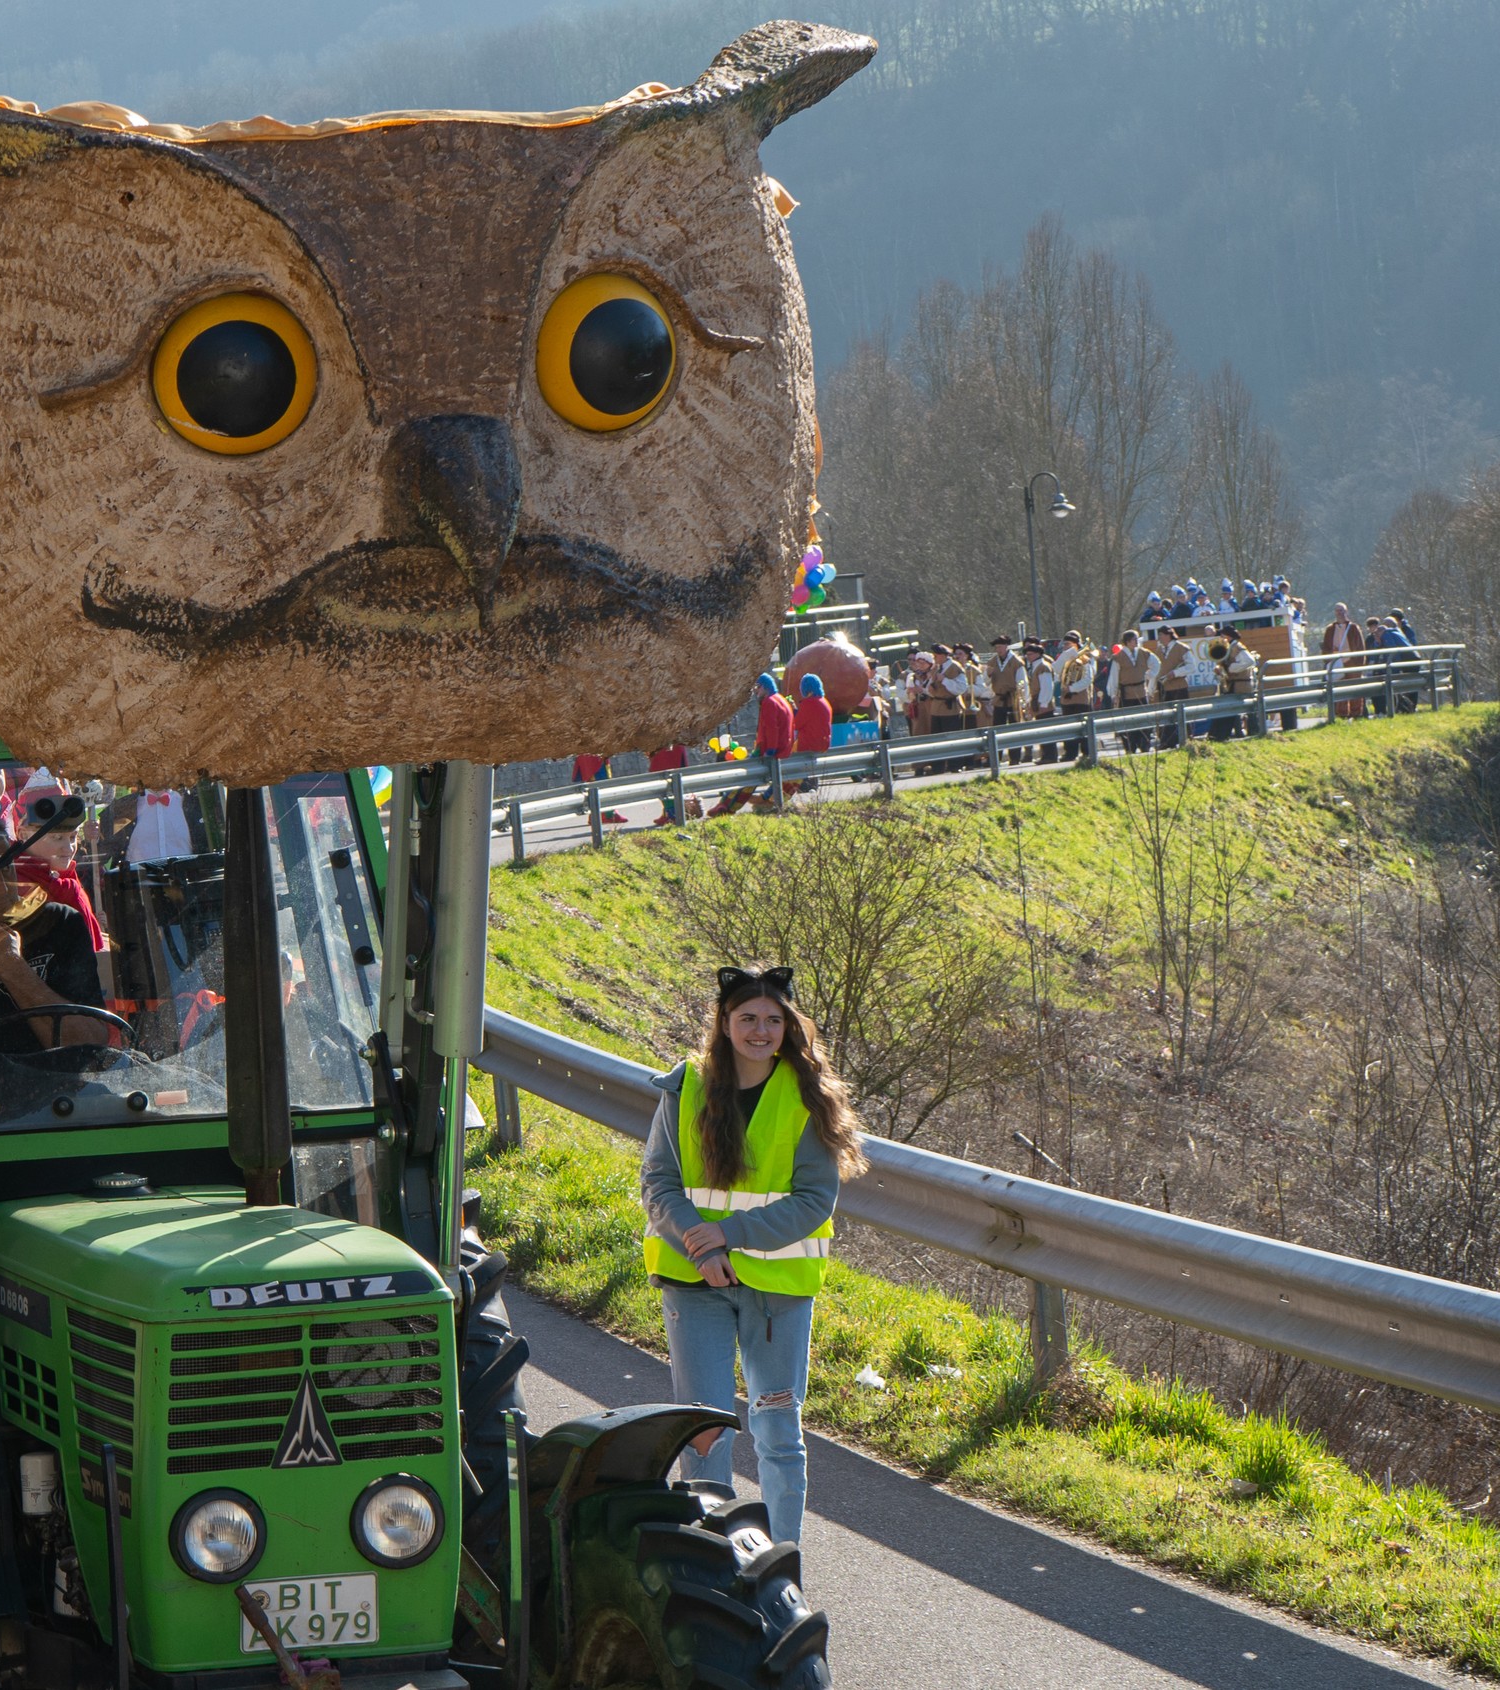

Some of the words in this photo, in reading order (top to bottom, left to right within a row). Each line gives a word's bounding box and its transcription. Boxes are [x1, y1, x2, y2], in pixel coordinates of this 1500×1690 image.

[209, 1275, 396, 1307] DEUTZ
[81, 1466, 132, 1509] Synon
[278, 1581, 342, 1611] BIT
